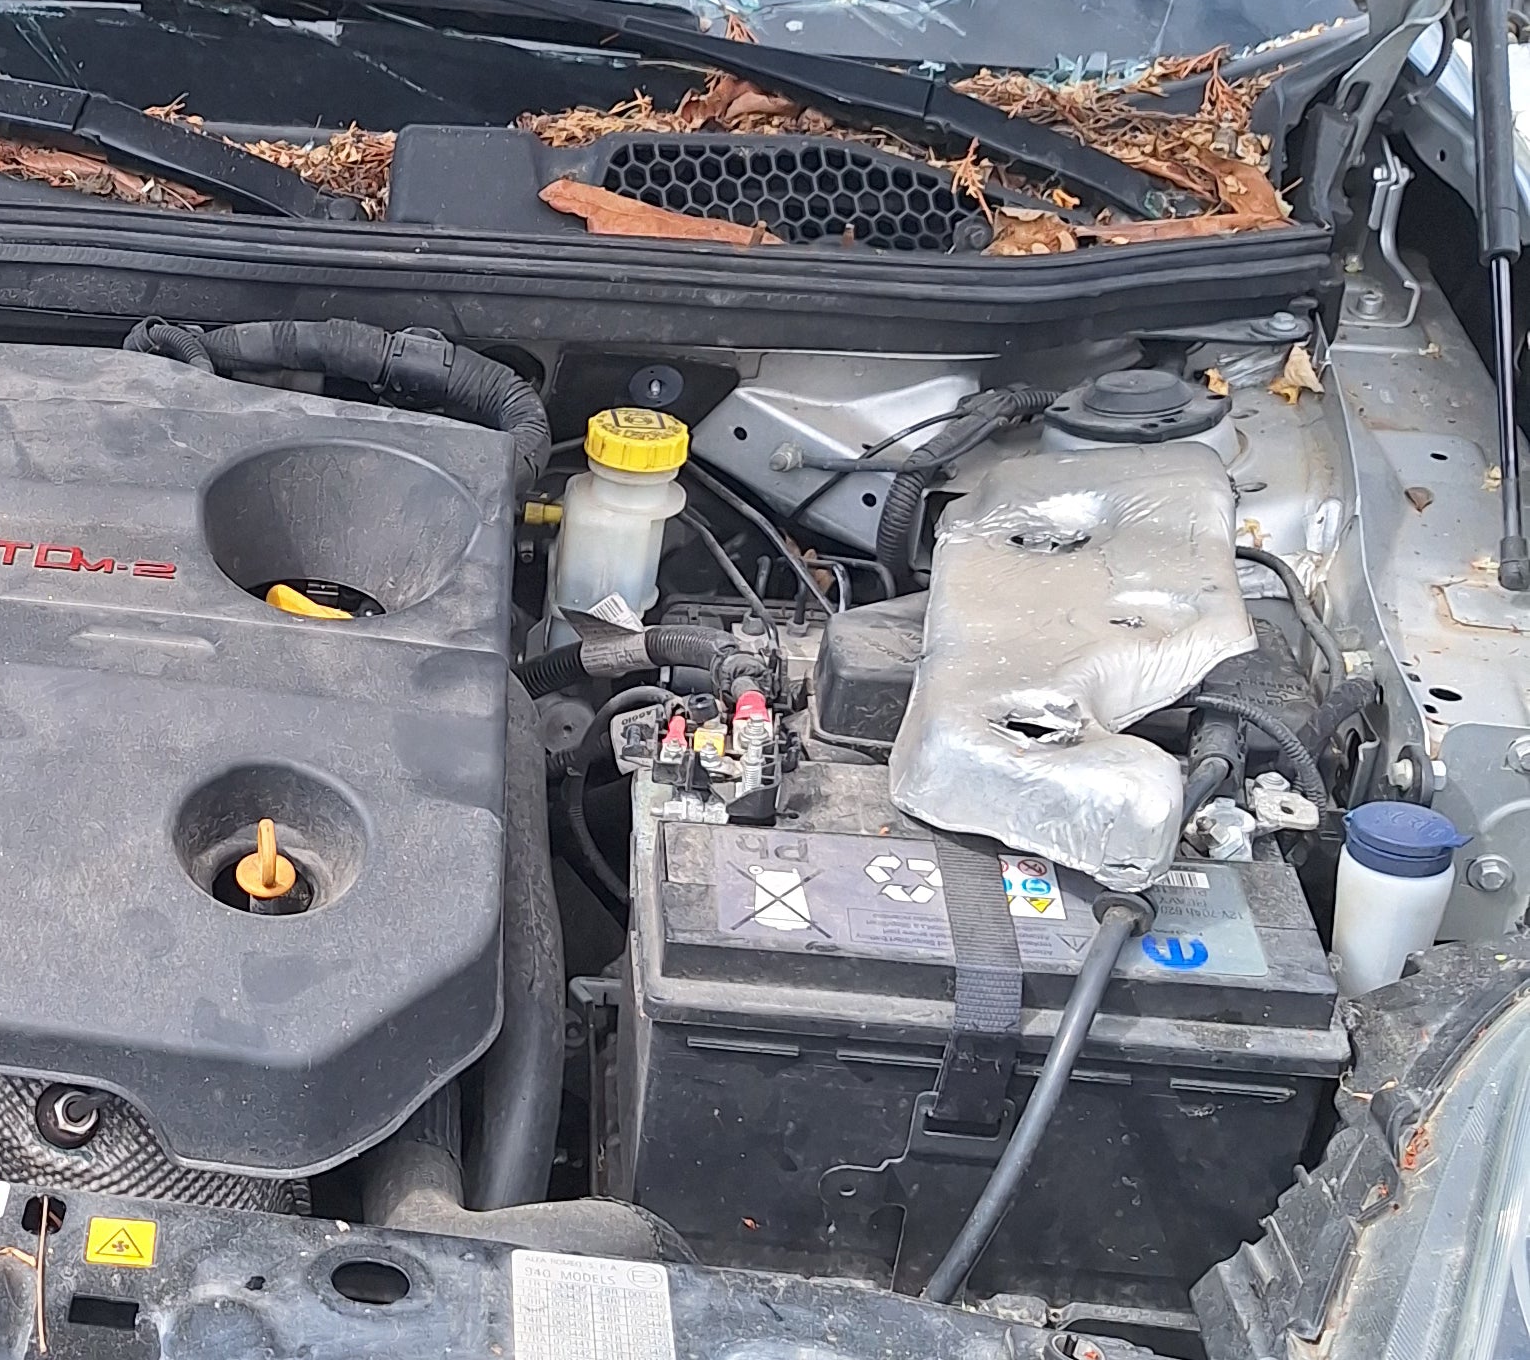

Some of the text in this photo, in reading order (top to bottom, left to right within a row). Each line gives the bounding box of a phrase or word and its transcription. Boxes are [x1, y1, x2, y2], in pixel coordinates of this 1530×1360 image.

[735, 833, 810, 864] Pb
[524, 1255, 545, 1263] ALFA
[524, 1267, 615, 1285] 940 MODELS
